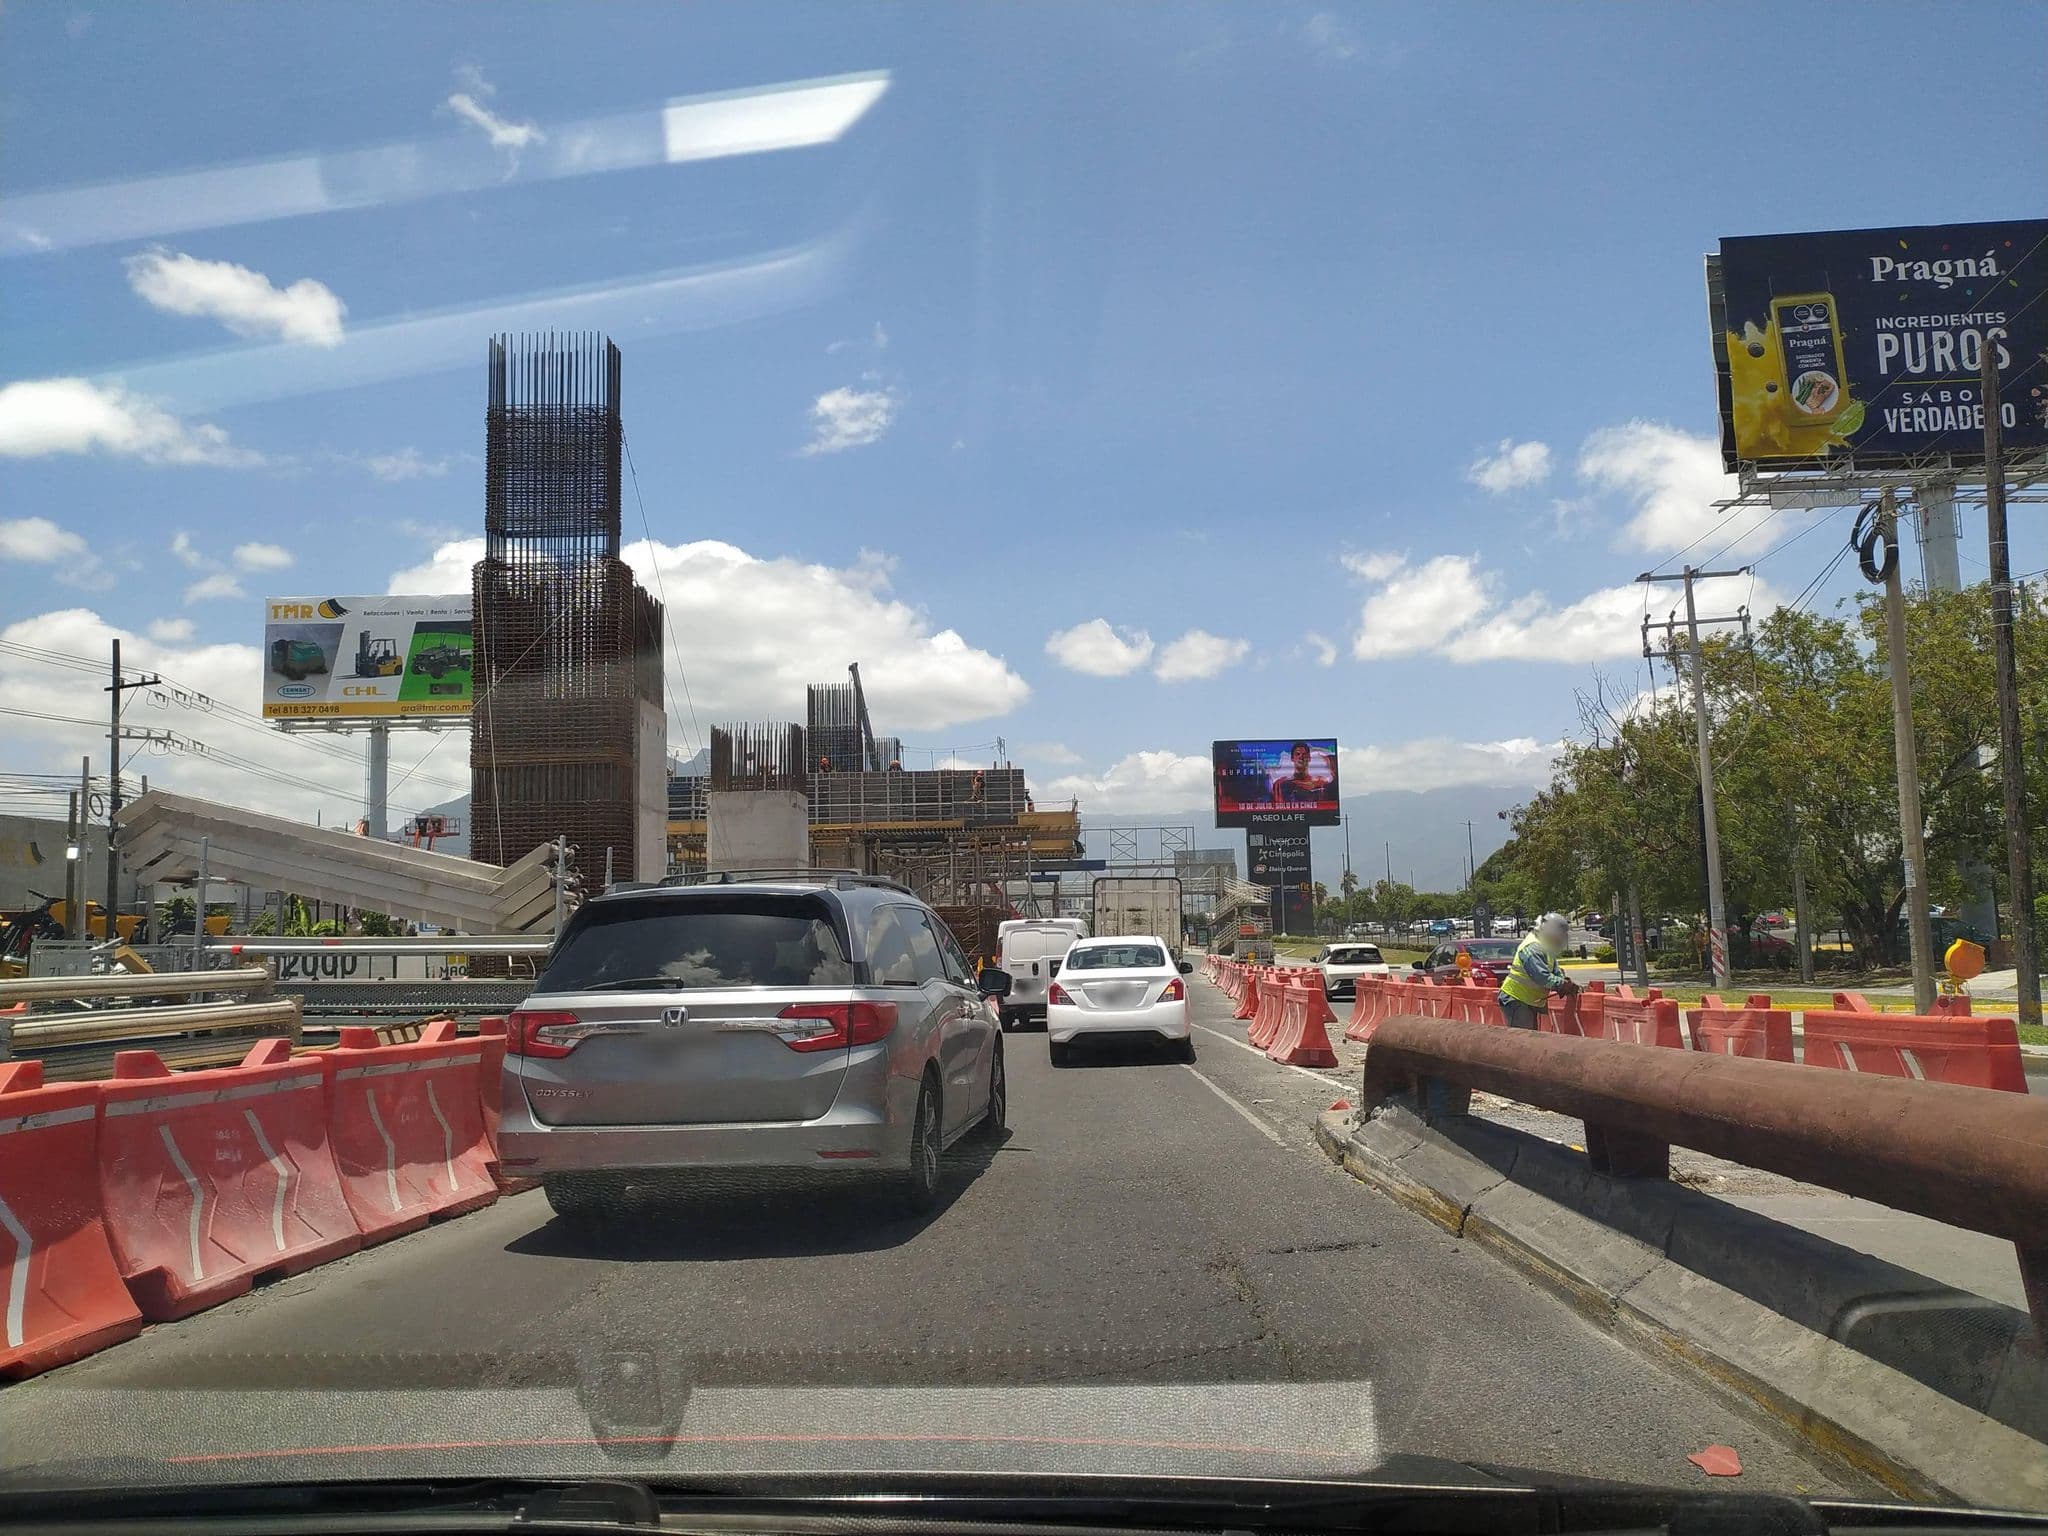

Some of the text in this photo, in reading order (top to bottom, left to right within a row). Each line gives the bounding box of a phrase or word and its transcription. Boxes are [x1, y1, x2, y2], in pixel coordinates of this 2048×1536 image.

[1869, 249, 2000, 289] Pragná
[1876, 312, 2007, 329] INGREDIENTES
[1789, 335, 1827, 349] Pragná
[1877, 327, 2011, 374] PUROS
[1902, 389, 1984, 404] SABO
[1883, 402, 2017, 433] VERDADEO
[271, 604, 314, 619] TMR
[343, 686, 386, 696] CHL
[268, 706, 281, 714] Tel
[300, 705, 316, 714] 327
[1252, 814, 1280, 822] PASEO
[1295, 813, 1305, 821] FE
